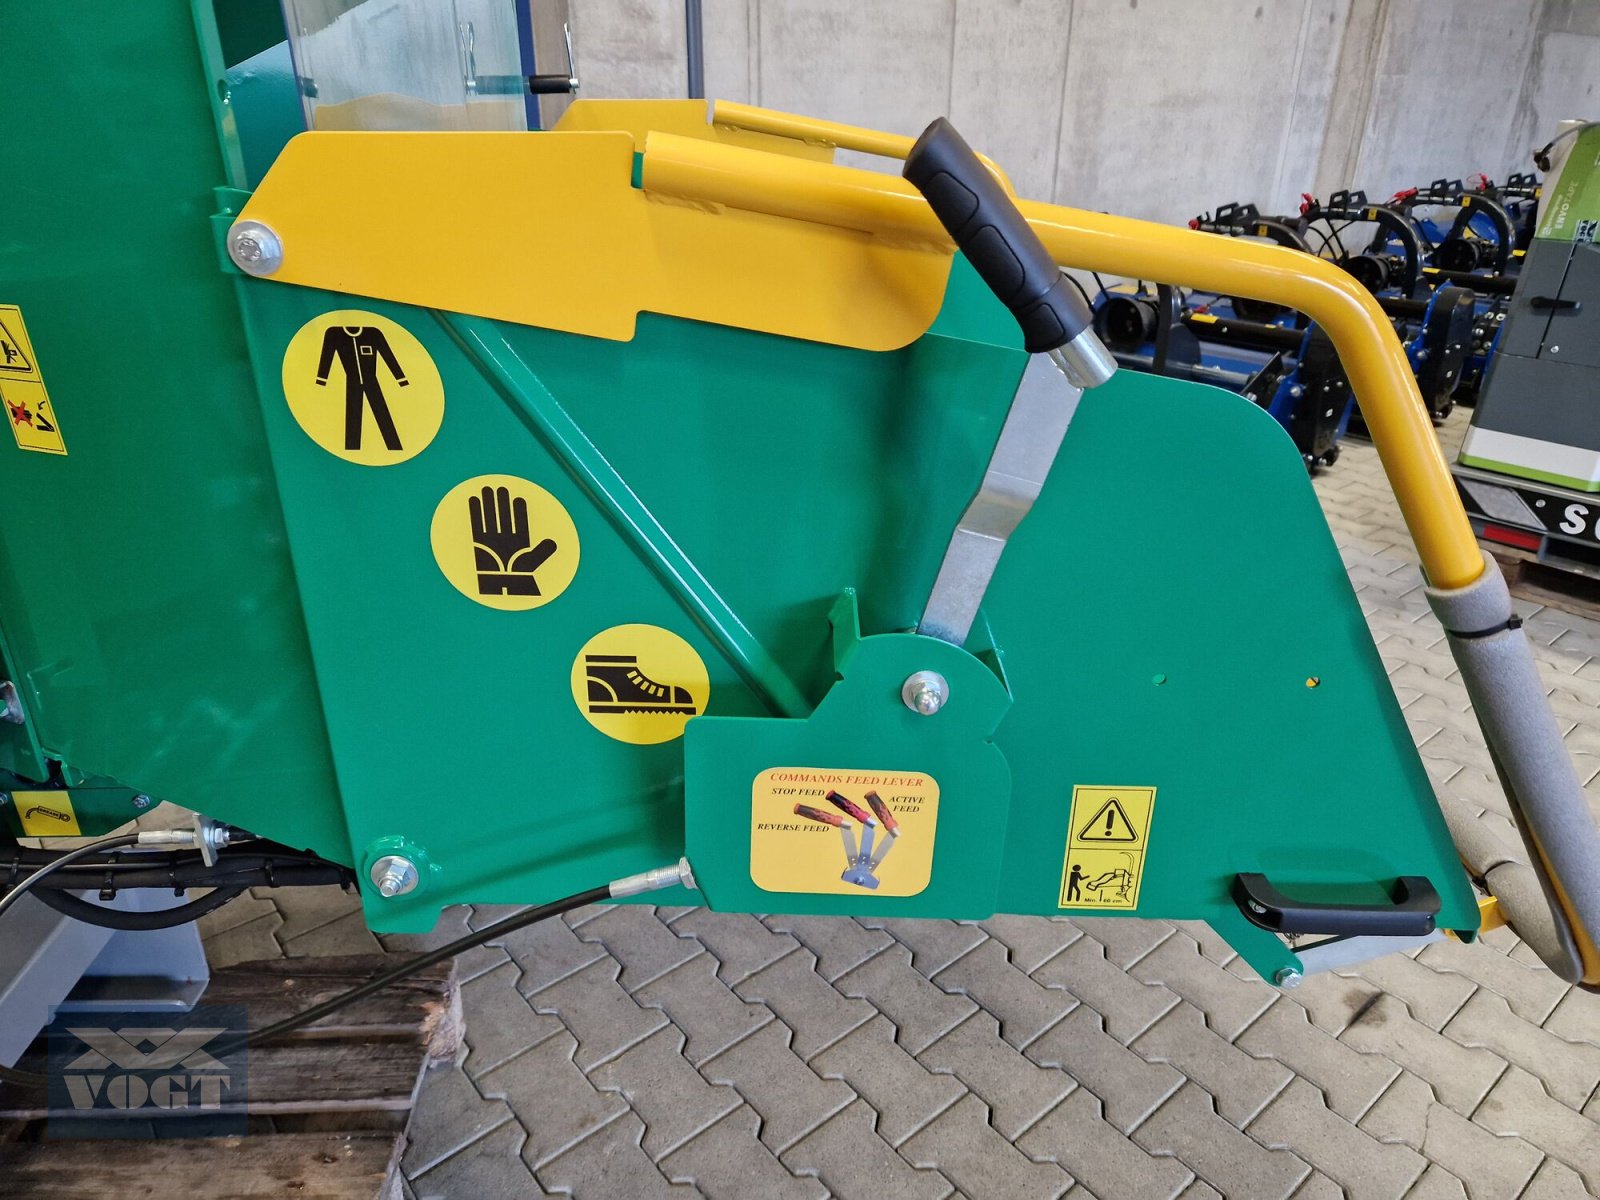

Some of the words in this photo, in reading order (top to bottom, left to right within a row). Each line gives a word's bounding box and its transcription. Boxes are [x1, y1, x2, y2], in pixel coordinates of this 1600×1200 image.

[1559, 503, 1600, 541] S
[770, 773, 842, 784] COMMANDS
[846, 776, 880, 785] FEED
[883, 777, 923, 787] LEVER
[771, 787, 798, 796] STOP
[798, 788, 825, 797] FEED
[889, 796, 926, 804] ACTIVE
[893, 805, 920, 813] FEED
[757, 823, 801, 832] REVERSE
[803, 824, 830, 833] FEED
